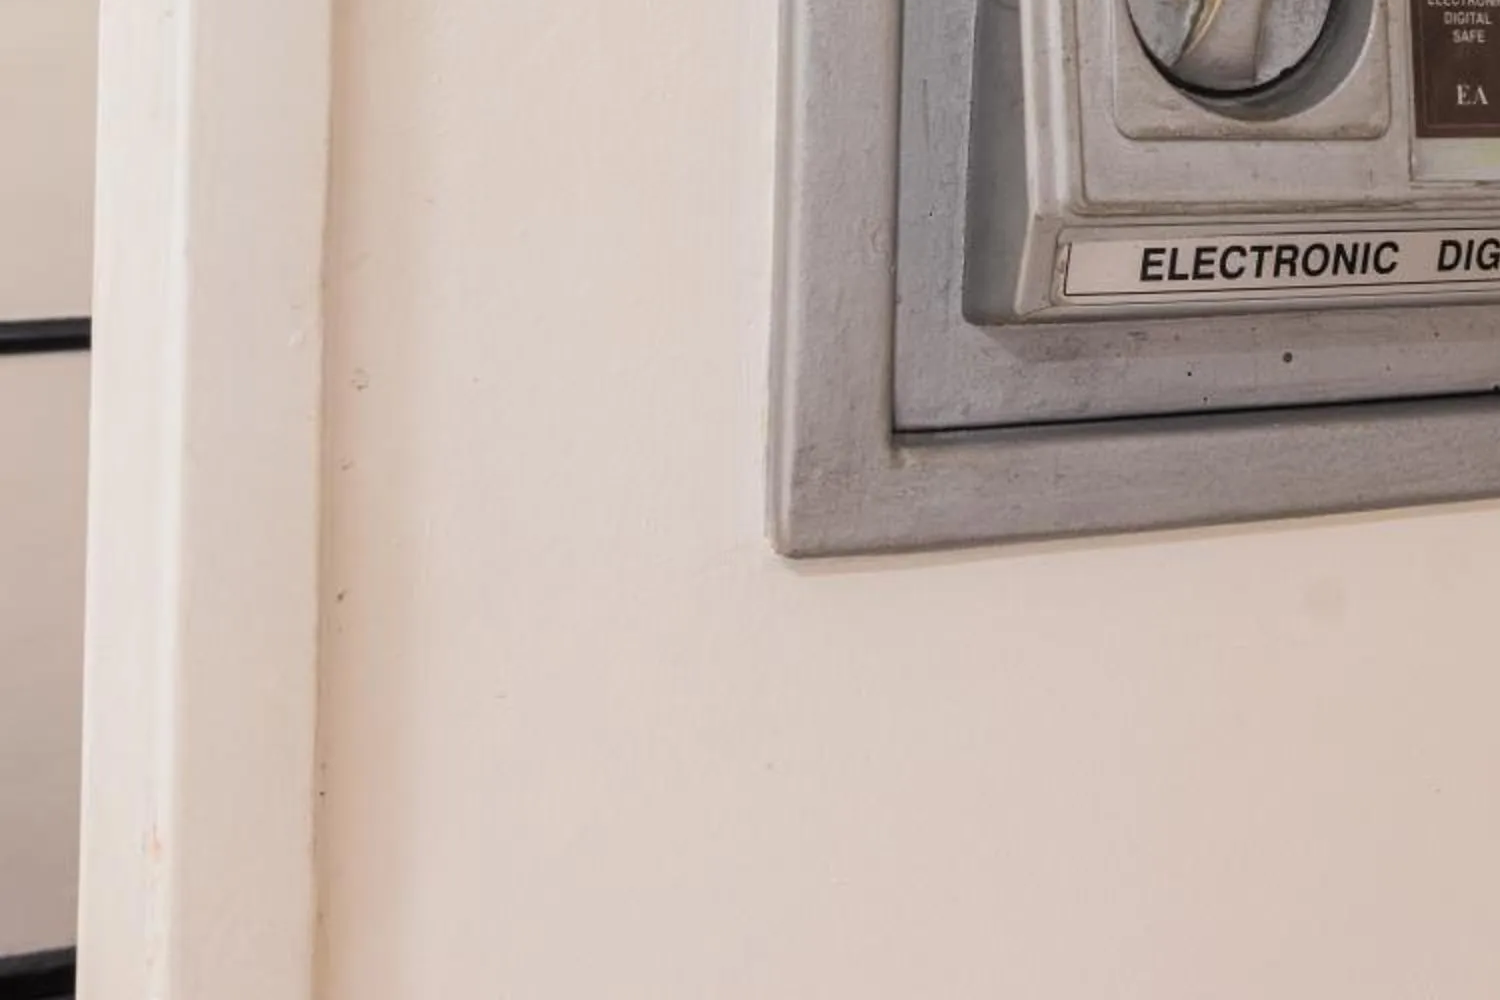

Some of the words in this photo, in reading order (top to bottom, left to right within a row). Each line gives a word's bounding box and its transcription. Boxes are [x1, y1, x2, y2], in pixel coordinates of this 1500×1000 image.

[1443, 11, 1492, 25] DIGITAL
[1452, 29, 1486, 43] SAFE
[1456, 84, 1488, 105] EA
[1139, 241, 1400, 282] ELECTRONIC
